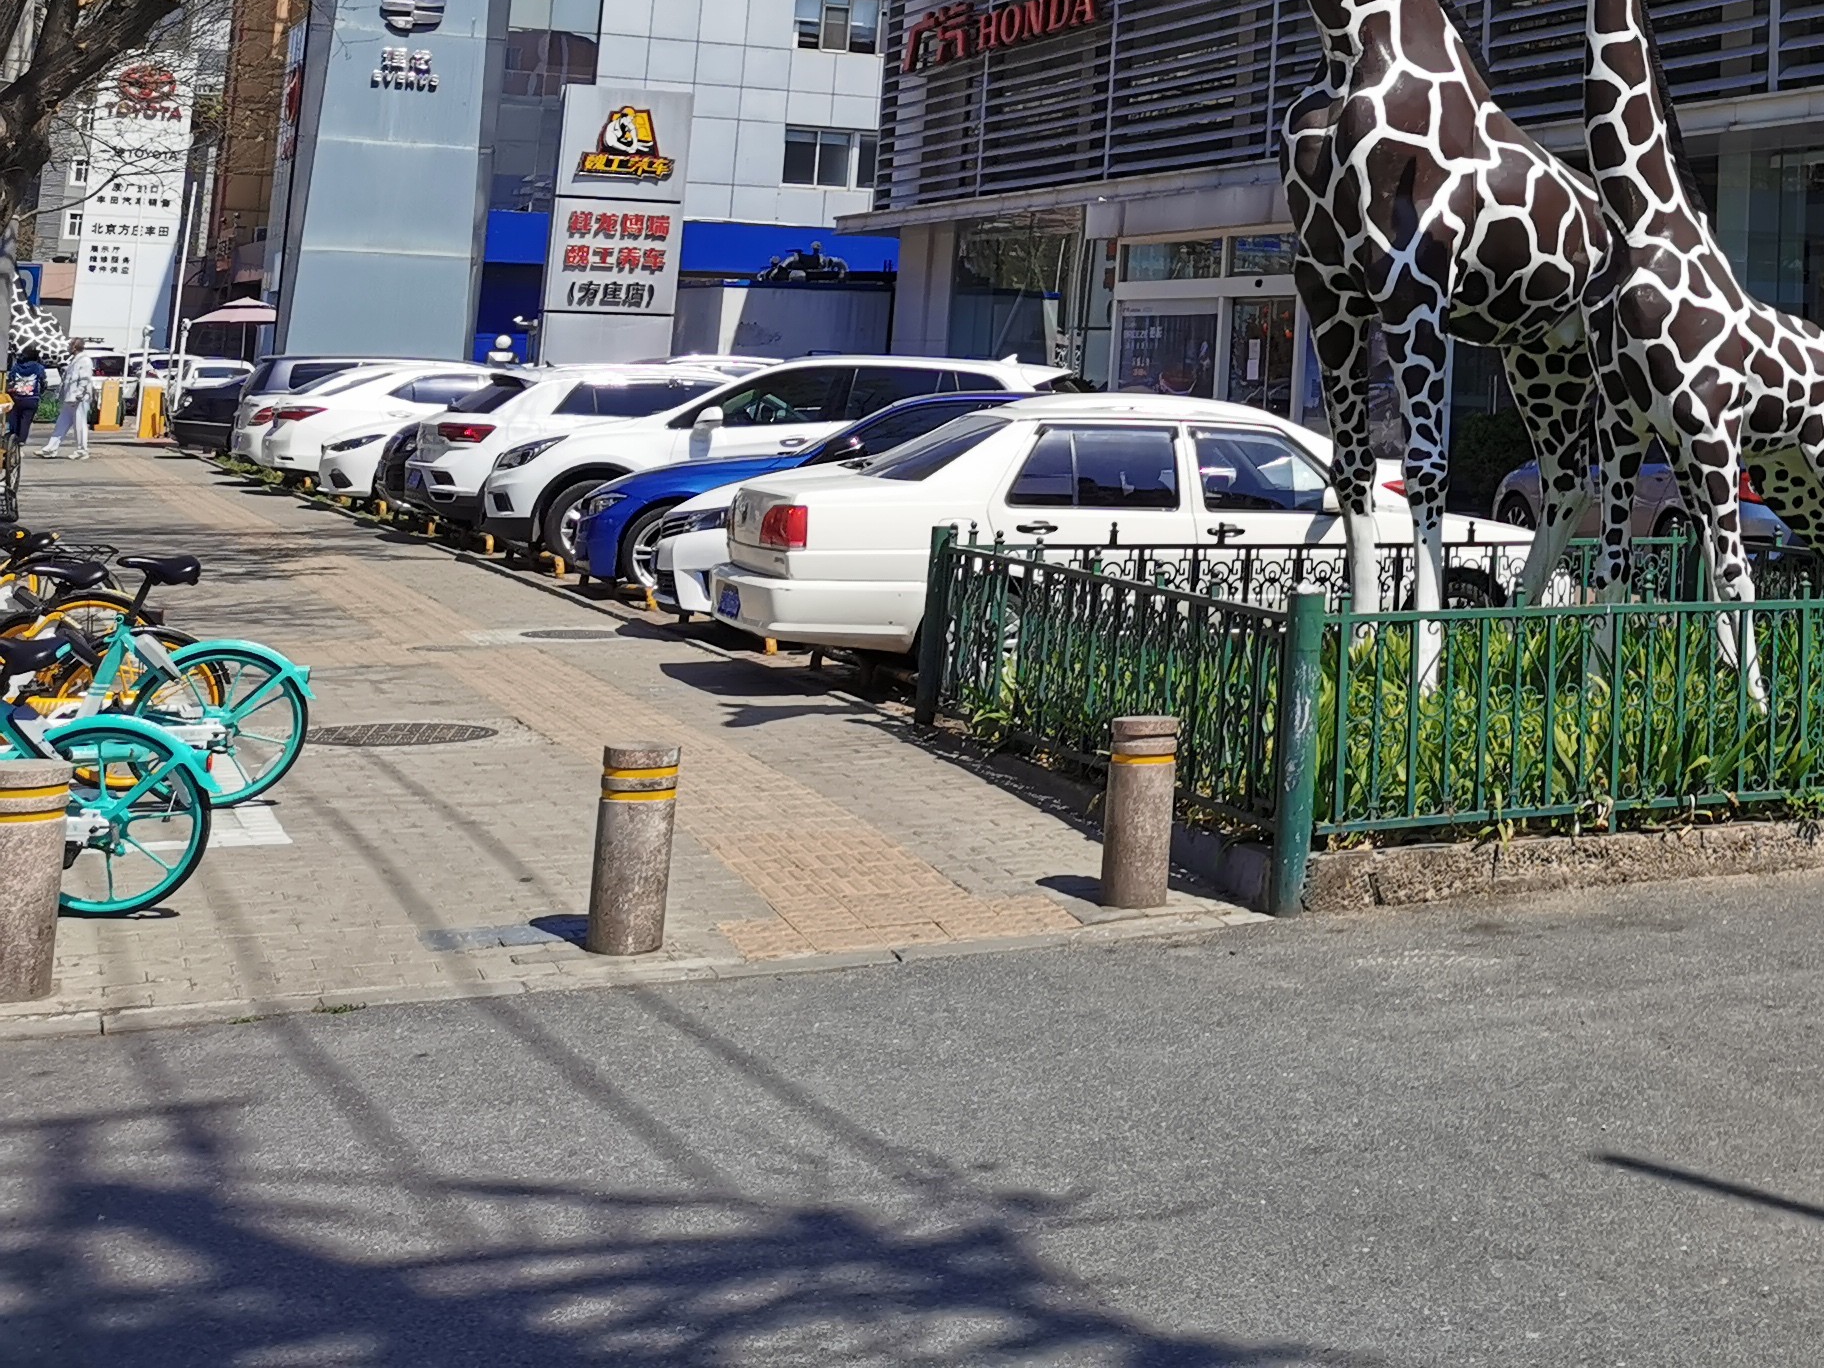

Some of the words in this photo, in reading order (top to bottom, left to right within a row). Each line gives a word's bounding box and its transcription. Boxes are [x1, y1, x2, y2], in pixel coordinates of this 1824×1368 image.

[104, 100, 182, 123] TOYOTA
[567, 210, 671, 241] 祥龙博瑞
[563, 244, 667, 273] 魏工养车
